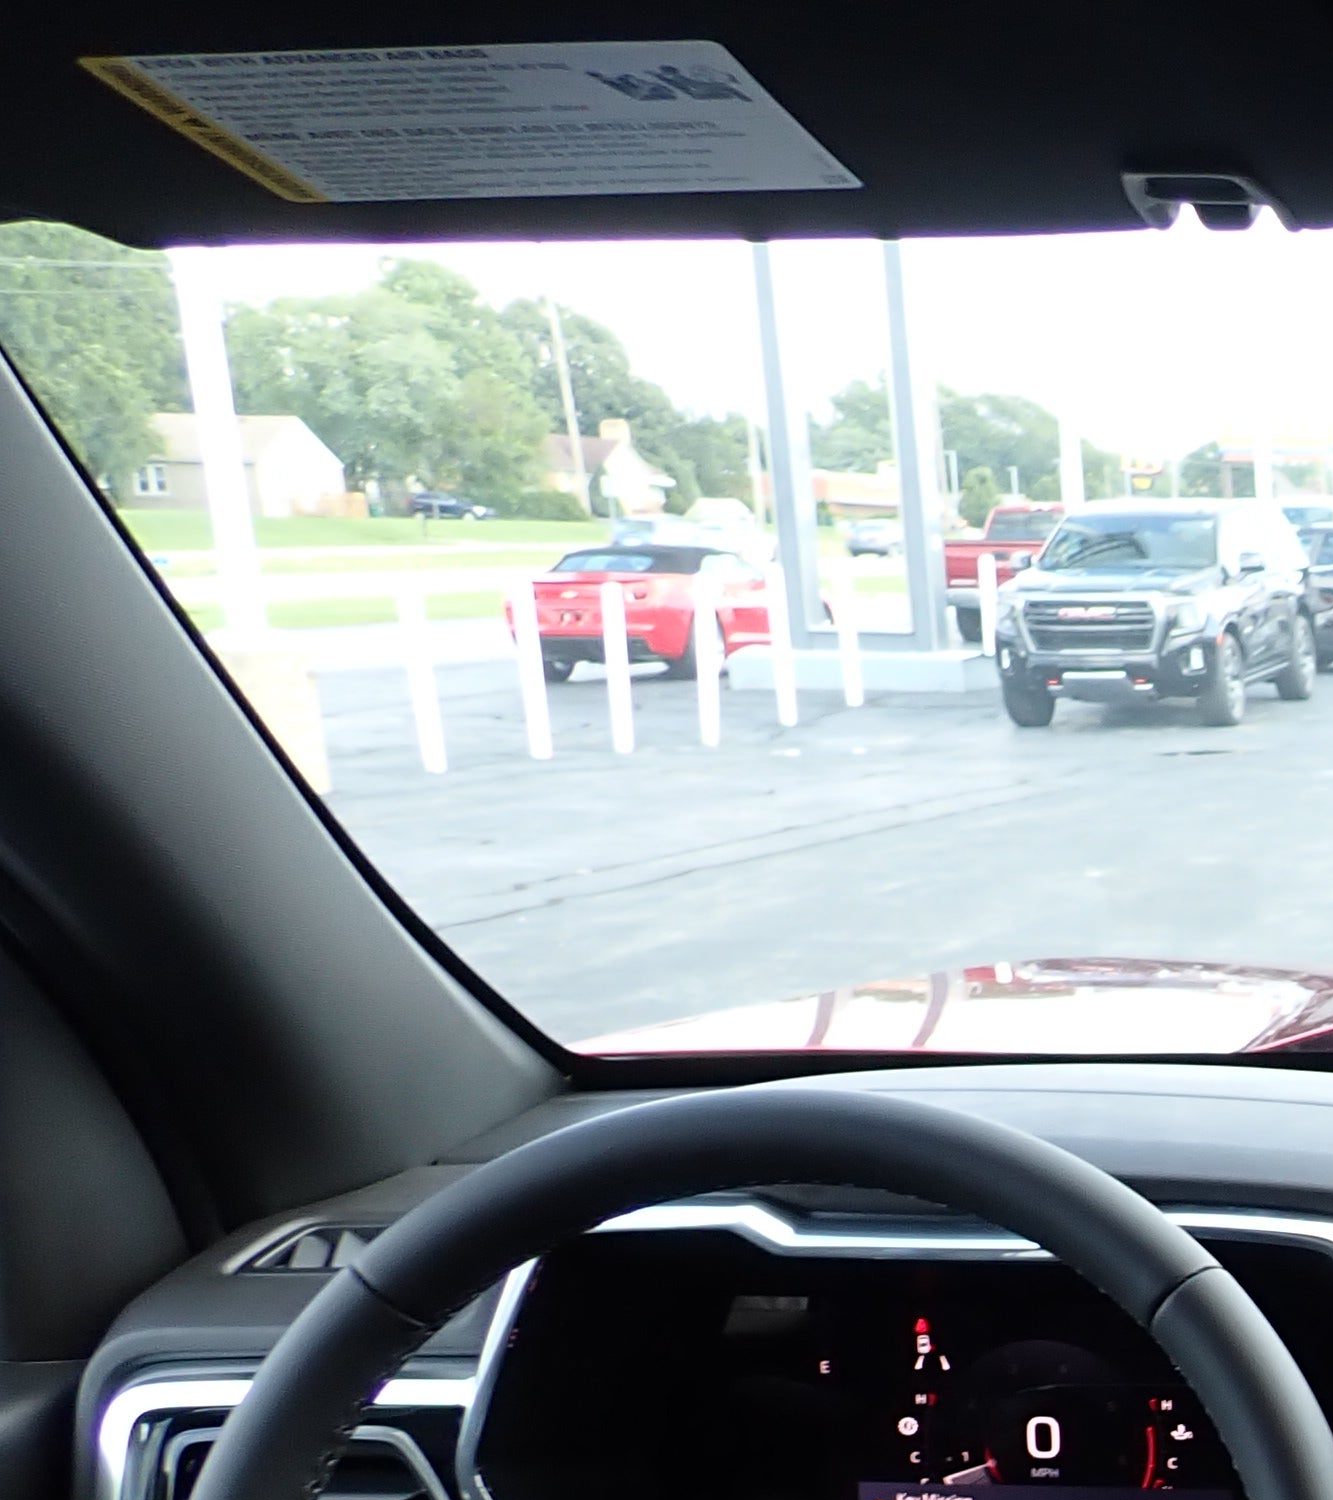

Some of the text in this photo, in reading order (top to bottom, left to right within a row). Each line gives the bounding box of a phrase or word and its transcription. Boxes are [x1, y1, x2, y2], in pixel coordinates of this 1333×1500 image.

[819, 1361, 831, 1375] E
[1025, 1415, 1061, 1460] 0
[1166, 1456, 1179, 1470] C
[1029, 1466, 1060, 1479] MPH
